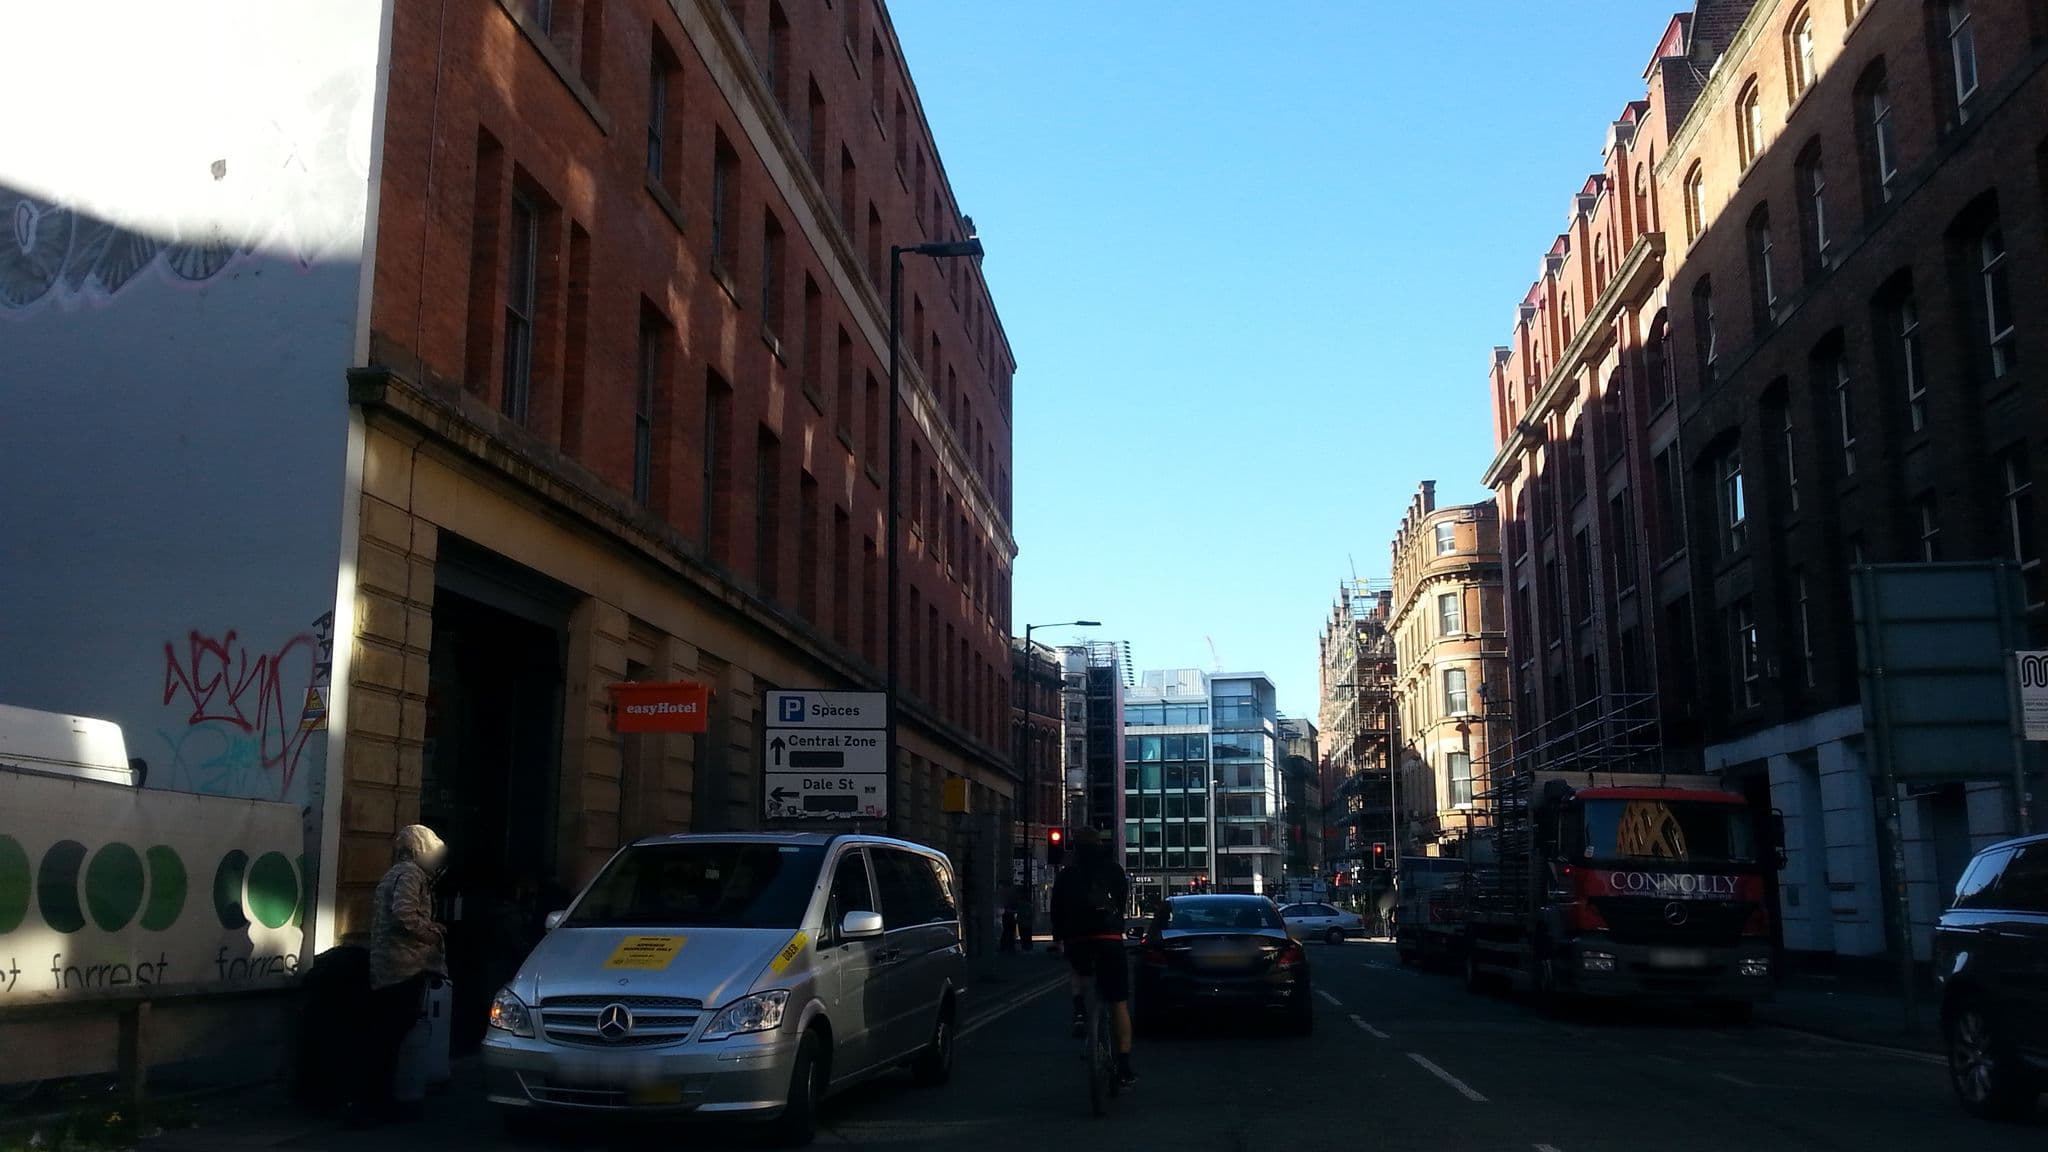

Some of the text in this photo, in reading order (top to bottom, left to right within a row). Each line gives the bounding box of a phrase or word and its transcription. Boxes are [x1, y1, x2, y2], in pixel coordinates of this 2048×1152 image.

[626, 702, 697, 715] easyHotel
[811, 704, 860, 717] Spaces
[788, 734, 877, 747] Central Zone
[803, 778, 833, 790] Dale
[838, 779, 855, 790] St
[1610, 870, 1739, 894] CONNOLLY
[782, 943, 799, 961] UBER
